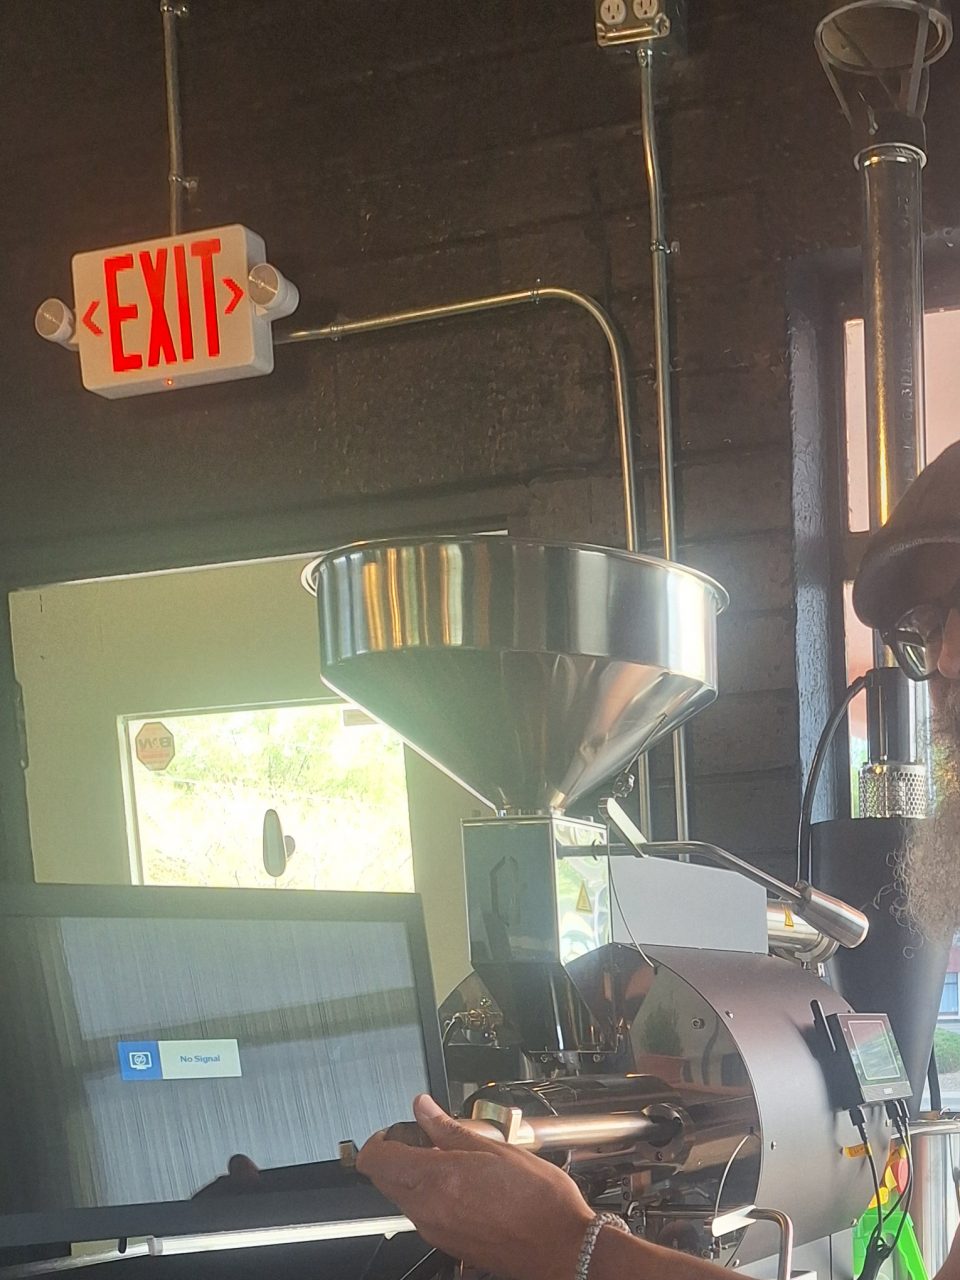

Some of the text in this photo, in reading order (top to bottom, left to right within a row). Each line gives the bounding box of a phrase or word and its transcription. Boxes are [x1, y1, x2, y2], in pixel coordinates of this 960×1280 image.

[104, 238, 221, 373] EXIT
[180, 1055, 221, 1063] No Signal
